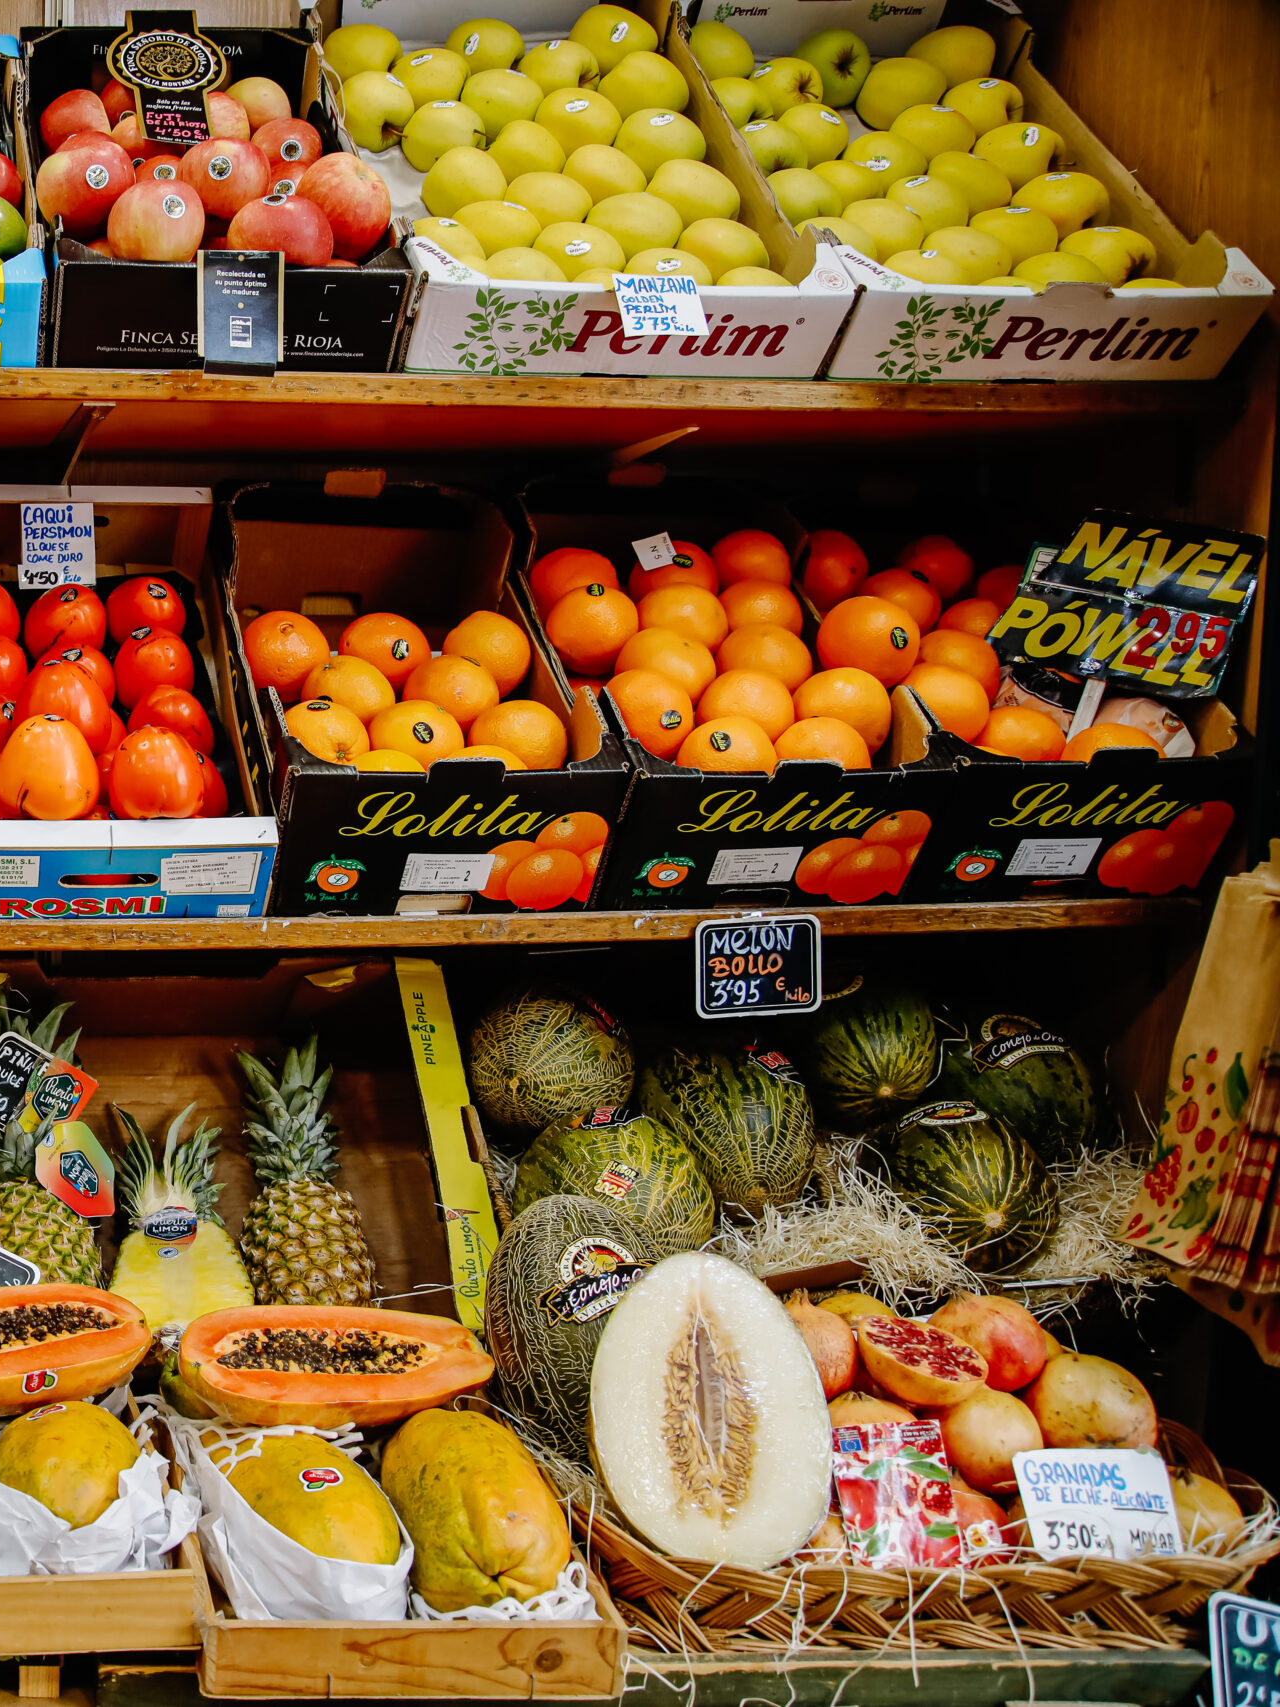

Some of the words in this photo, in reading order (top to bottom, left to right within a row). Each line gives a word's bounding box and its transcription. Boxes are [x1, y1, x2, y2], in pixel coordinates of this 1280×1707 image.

[177, 36, 191, 47] DE
[142, 76, 161, 87] ALTA
[161, 78, 195, 88] MONTAÑA
[216, 270, 256, 279] Recolectada
[223, 280, 243, 289] punto
[244, 280, 268, 290] óptimo
[232, 288, 260, 297] madurez
[615, 277, 698, 295] MANZANA
[621, 295, 664, 304] GOLDEN
[632, 315, 671, 332] 3'75
[120, 329, 172, 345] FINCA
[294, 334, 343, 349] RIOJA
[983, 315, 1202, 362] Perlim
[23, 525, 92, 540] PERSIMON
[26, 542, 38, 552] EL
[38, 541, 57, 552] QUE
[58, 542, 70, 552] SE
[26, 553, 54, 563] COME
[57, 552, 83, 564] DURO
[1057, 521, 1253, 604] NÁVEL
[676, 789, 886, 834] Lolita
[988, 782, 1191, 828] Lolita
[338, 791, 556, 837] Lolita
[770, 862, 780, 875] 2
[1067, 854, 1077, 867] 2
[463, 870, 471, 882] 2
[707, 953, 783, 978] BOLLO
[709, 979, 763, 1008] 3'95
[412, 991, 437, 1066] PINEAPPLE
[991, 1032, 1032, 1058] Conejo
[45, 1076, 74, 1102] Puerto
[568, 1273, 620, 1307] Conejo
[1023, 1459, 1127, 1491] GRANADAS
[1031, 1486, 1052, 1502] DE
